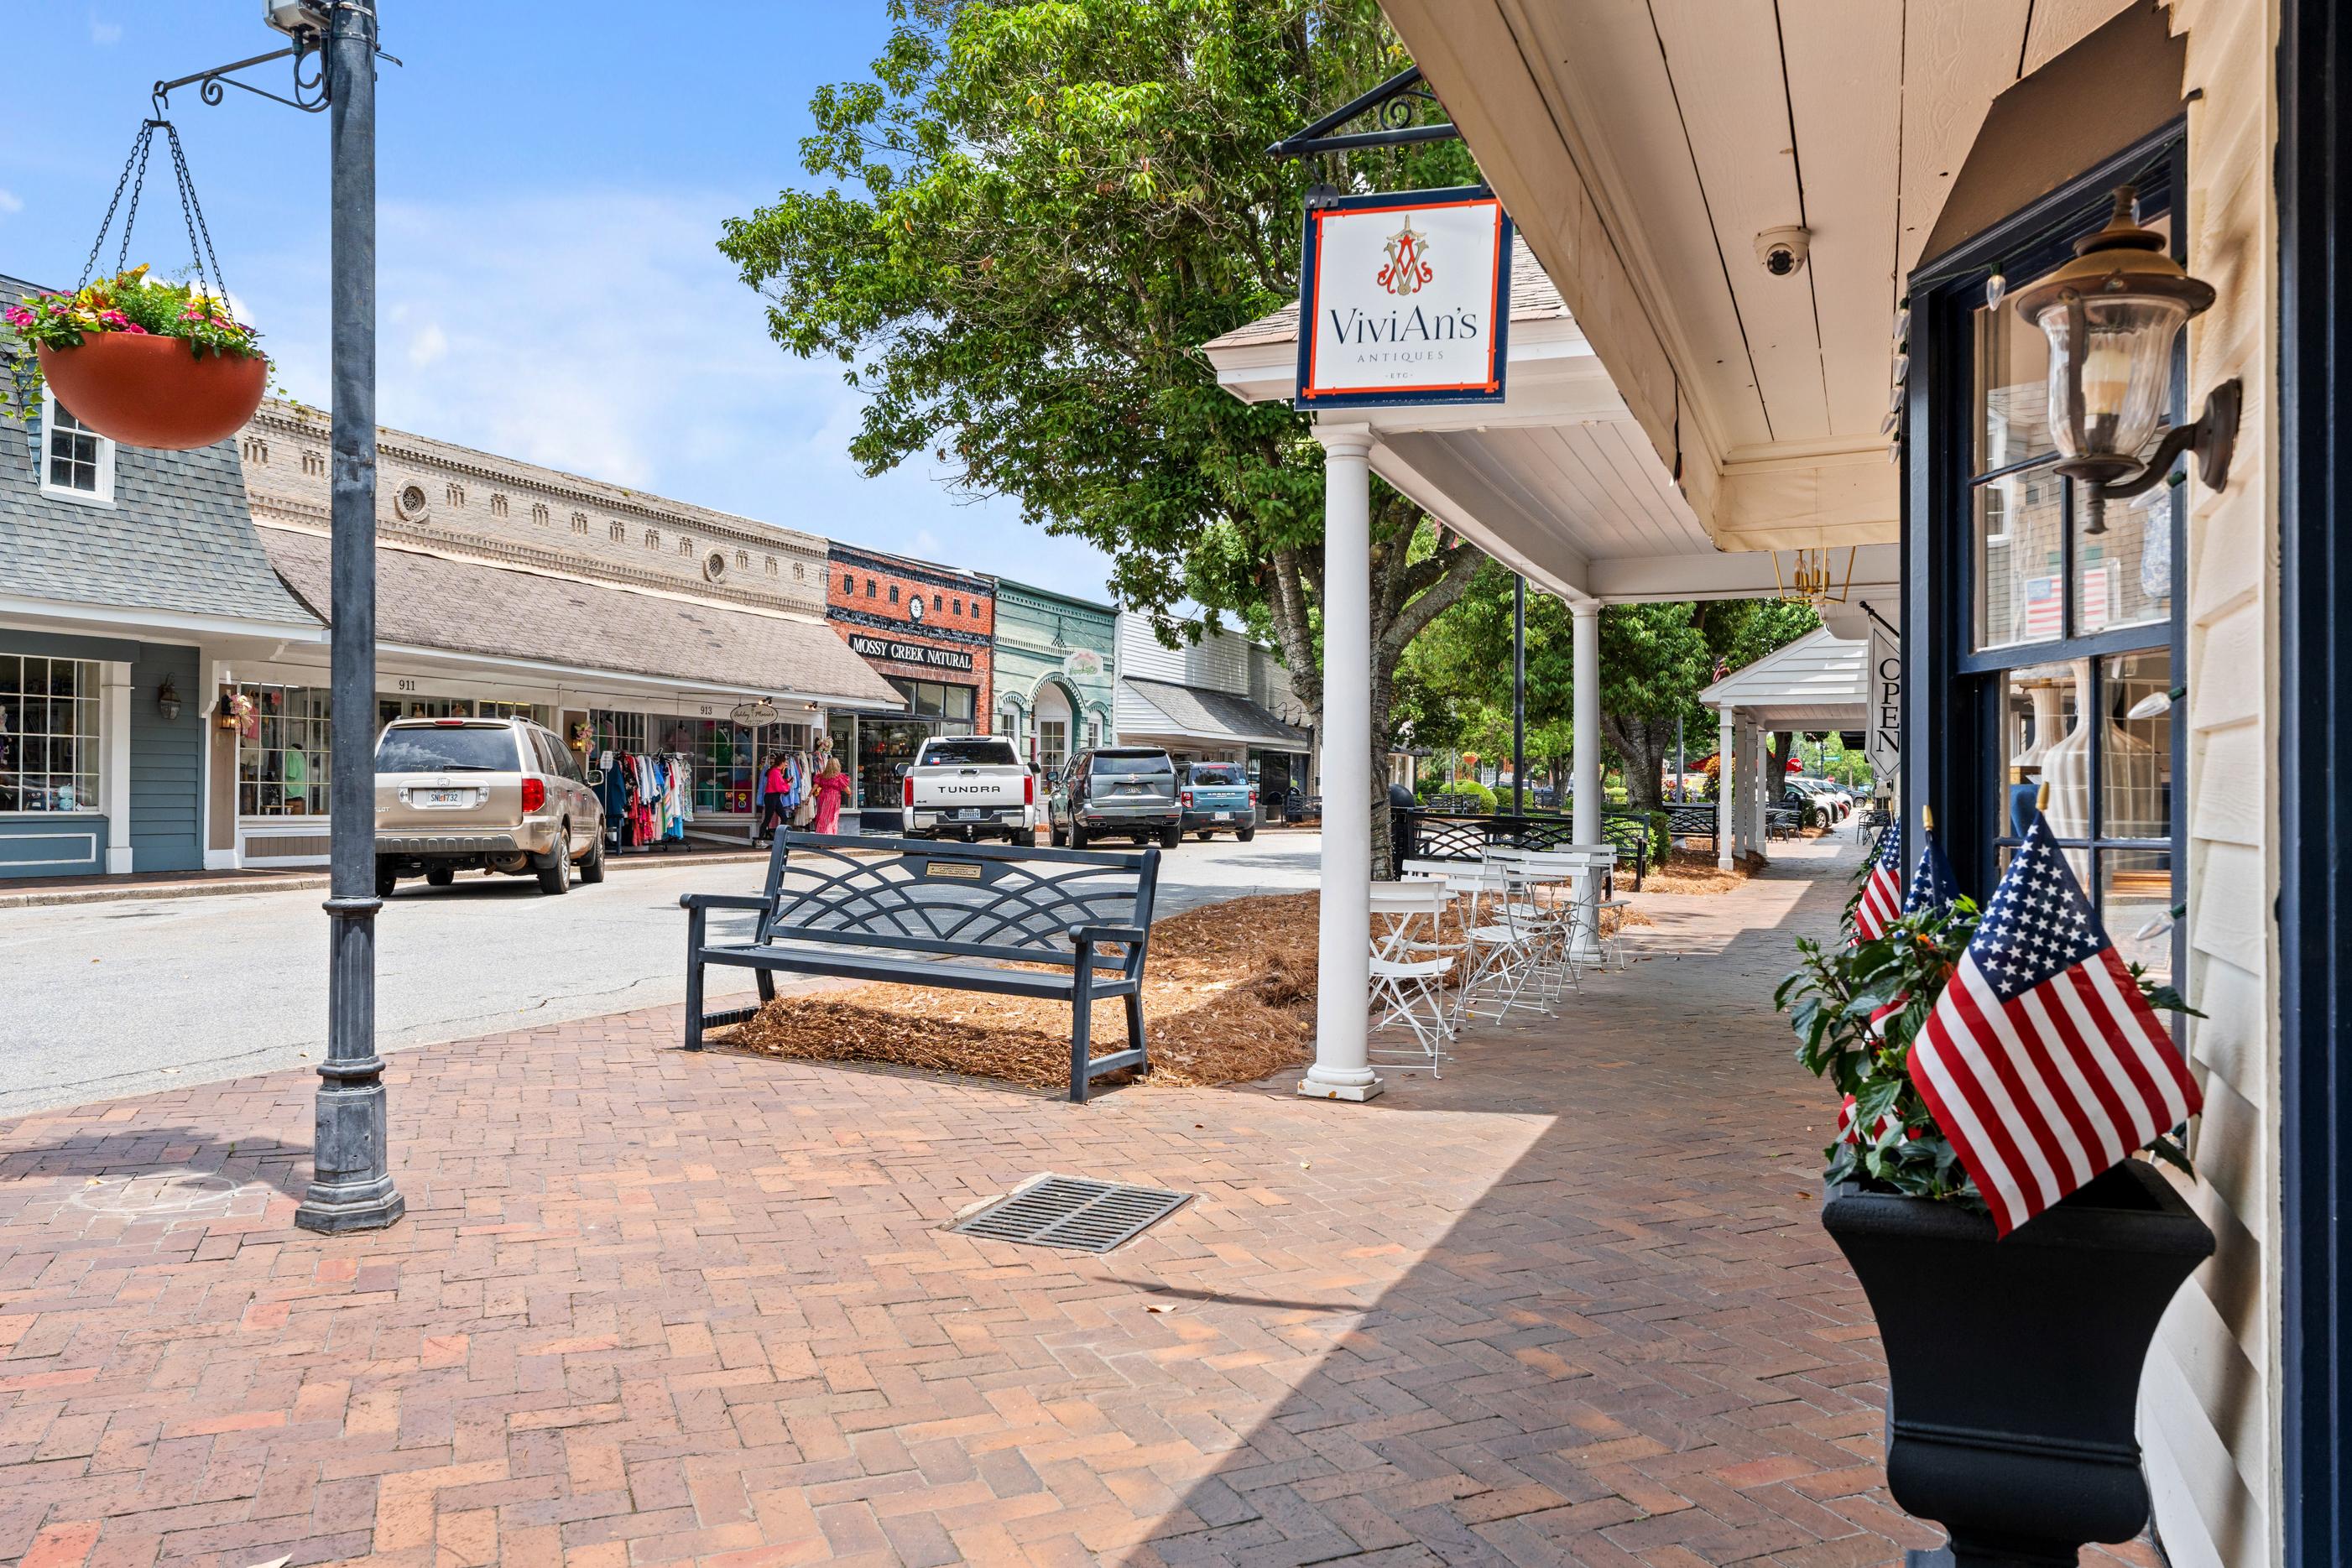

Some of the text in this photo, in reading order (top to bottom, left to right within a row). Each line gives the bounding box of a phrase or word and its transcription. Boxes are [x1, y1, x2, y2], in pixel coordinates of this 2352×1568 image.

[1330, 305, 1478, 345] ViviAn's
[1357, 351, 1444, 363] ANTIQUES
[853, 637, 972, 669] MOSSY CREEK NATURAL
[399, 679, 415, 691] 911
[700, 706, 712, 716] 913
[1875, 658, 1901, 753] OPEN
